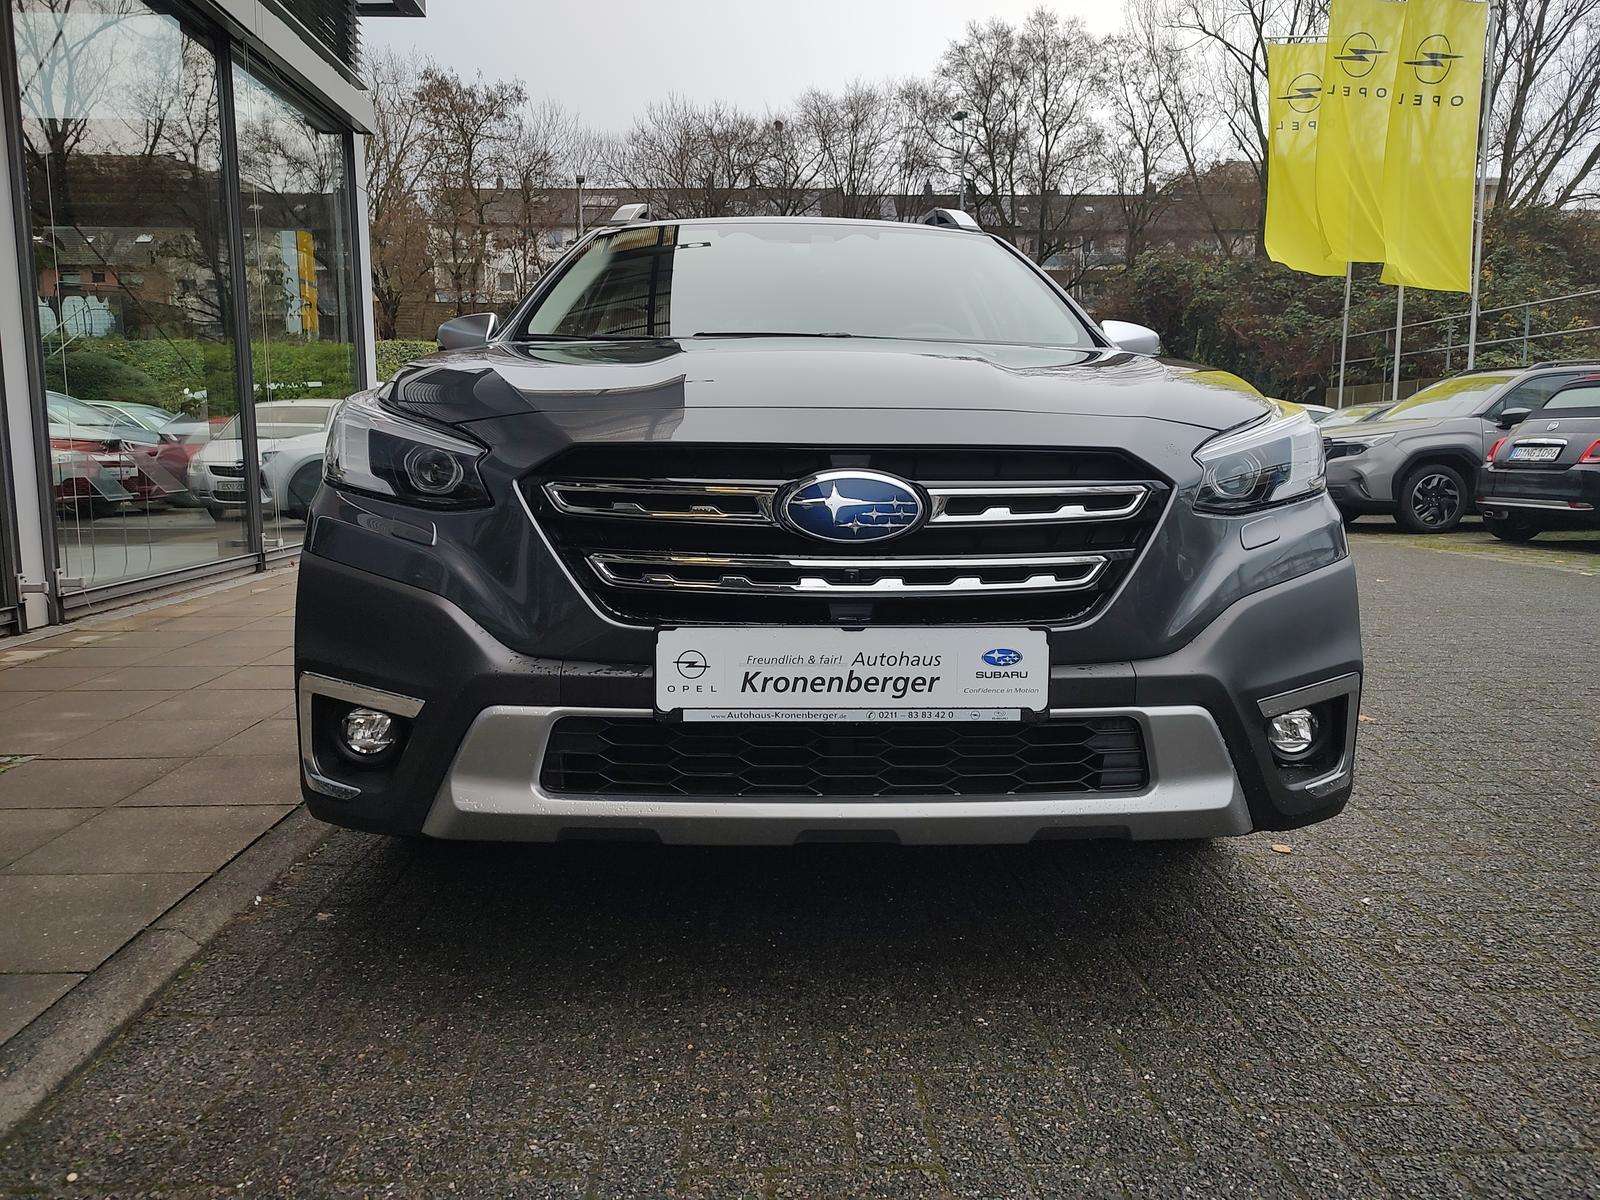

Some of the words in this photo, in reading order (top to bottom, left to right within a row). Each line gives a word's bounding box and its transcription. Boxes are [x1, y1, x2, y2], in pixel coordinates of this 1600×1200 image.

[746, 654, 804, 665] Freundlich
[807, 655, 816, 665] &
[819, 654, 843, 665] fair!
[851, 651, 942, 667] Autohaus
[975, 671, 1029, 679] SUBARU
[667, 685, 718, 693] OPEL
[740, 670, 941, 699] Kronenberger
[710, 711, 847, 721] www.Autohaus-Kronenberger.de
[878, 711, 897, 720] 0211
[908, 711, 919, 720] 83
[921, 711, 933, 720] 83
[936, 711, 946, 720] 42
[947, 711, 955, 720] 0
